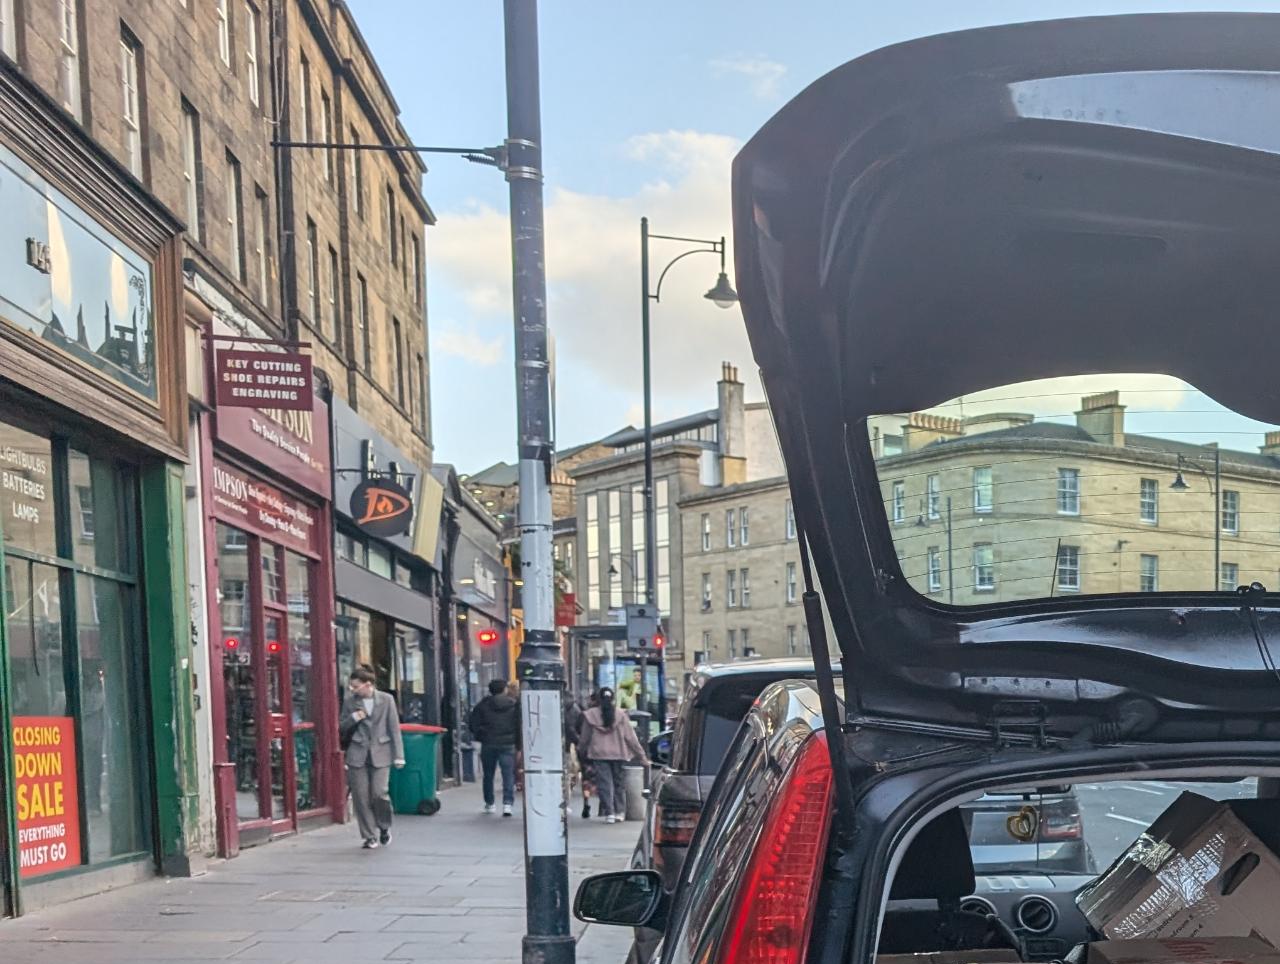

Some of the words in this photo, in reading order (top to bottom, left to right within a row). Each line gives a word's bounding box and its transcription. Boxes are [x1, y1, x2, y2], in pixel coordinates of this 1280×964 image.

[226, 359, 249, 369] KEY
[253, 360, 302, 373] CUTTING
[223, 372, 253, 383] SHOE
[256, 374, 306, 387] REPAIRS
[232, 387, 298, 401] ENGRAVING
[0, 445, 46, 475] LIGHTBULBS
[3, 472, 45, 500] BATTERIES
[13, 501, 39, 523] LAMPS
[12, 726, 61, 746] CLOSING
[15, 752, 62, 779] DOWN
[16, 781, 65, 822] SALE
[18, 823, 66, 844] EVERYTHING
[20, 846, 49, 868] MUST
[50, 842, 67, 862] GO
